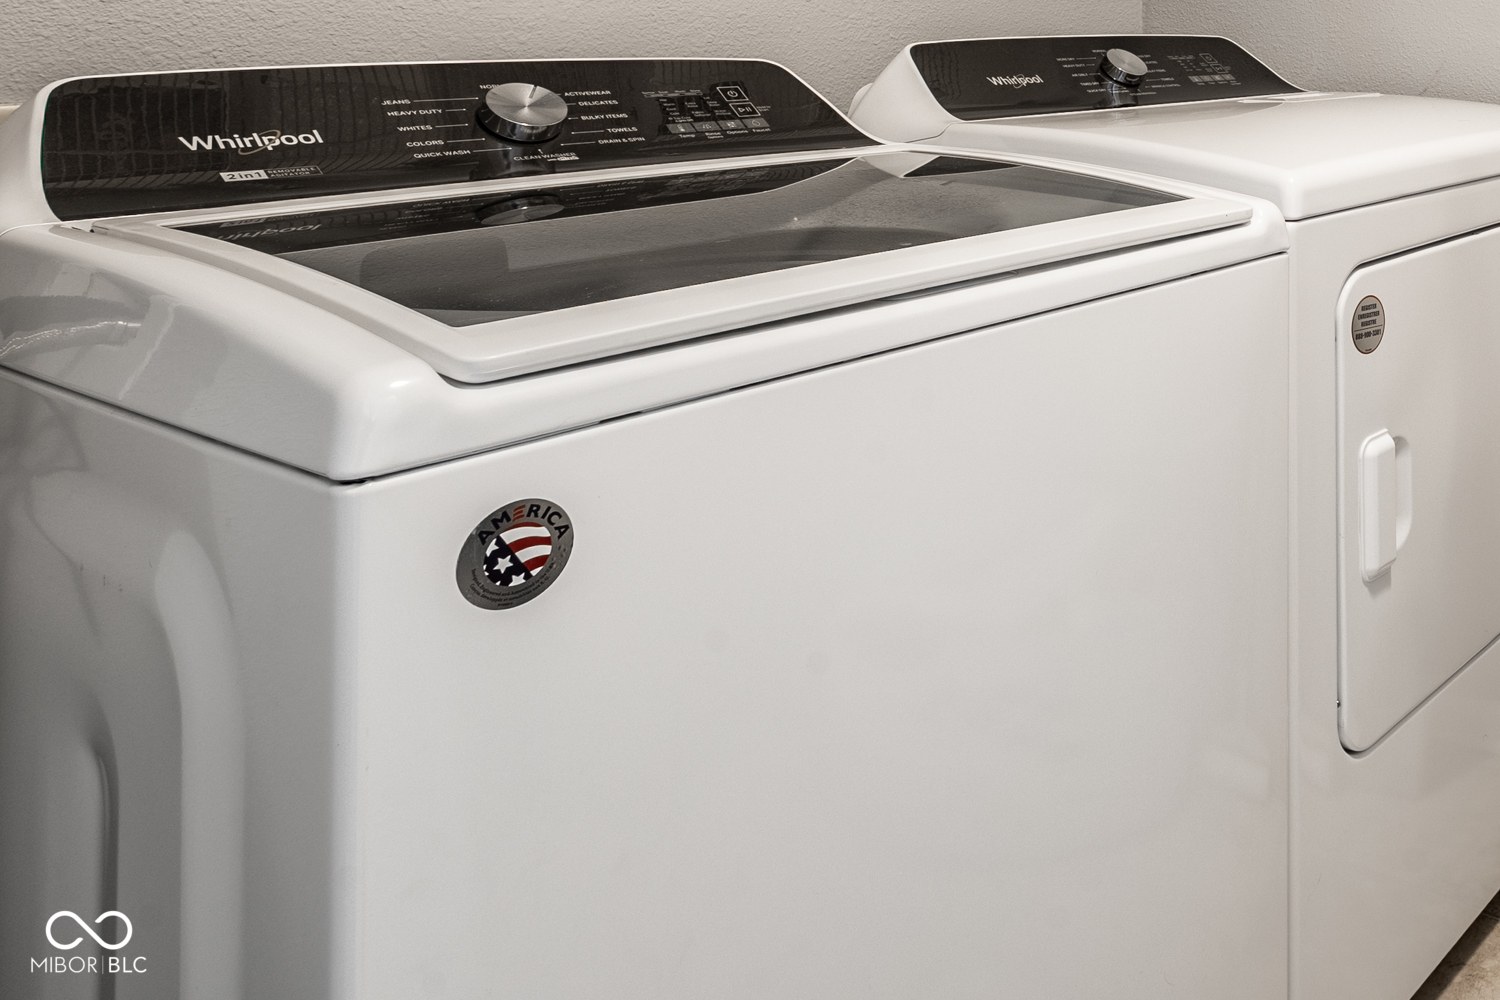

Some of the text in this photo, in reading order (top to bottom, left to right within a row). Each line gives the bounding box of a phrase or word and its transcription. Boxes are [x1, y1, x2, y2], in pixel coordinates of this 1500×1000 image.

[986, 74, 1044, 87] Whirlpool
[564, 89, 612, 97] ACTIVEWEAR
[387, 109, 417, 117] HEAVY
[396, 124, 433, 132] WHITES
[178, 129, 324, 151] Whirlpool
[405, 139, 445, 148] COLORS
[413, 148, 472, 160] QUICK WASH
[513, 154, 541, 162] CLEAN
[541, 151, 577, 159] WASHER
[267, 166, 317, 174] REMOVABLE
[477, 503, 571, 546] AMERICA
